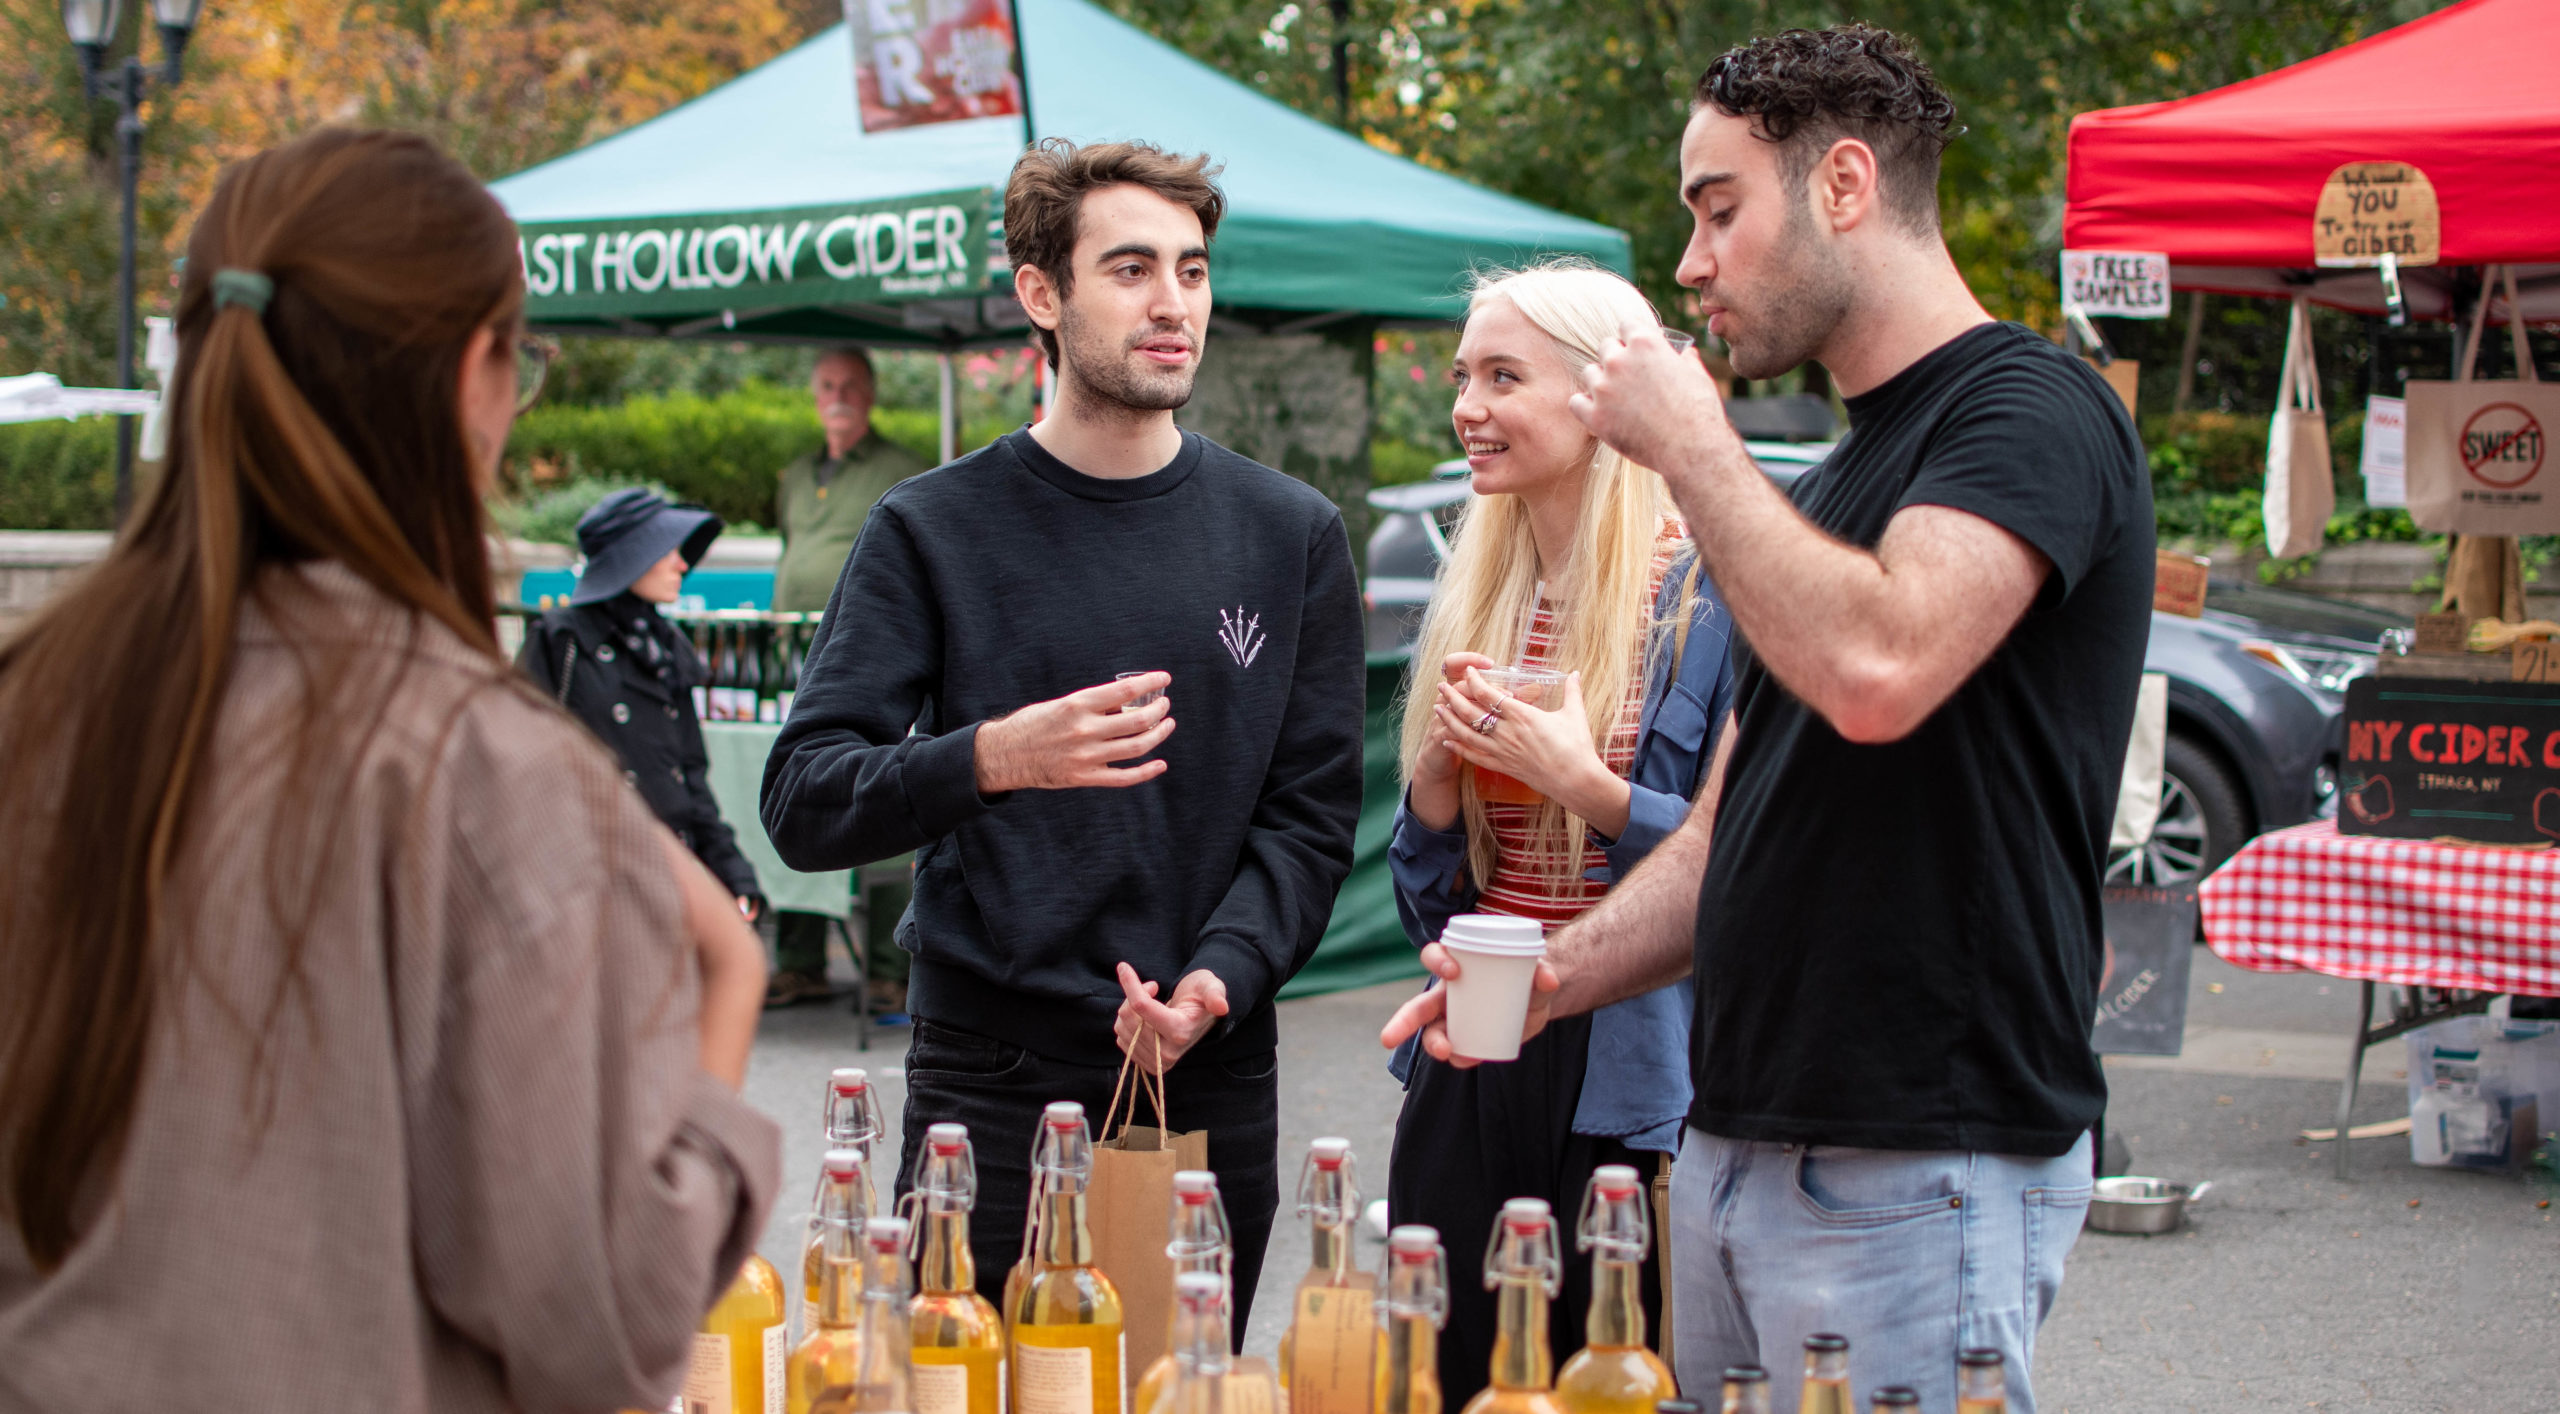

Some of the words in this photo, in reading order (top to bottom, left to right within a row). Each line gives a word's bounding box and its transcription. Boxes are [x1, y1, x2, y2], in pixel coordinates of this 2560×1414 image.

[2348, 189, 2398, 214] YOU
[591, 221, 810, 293] HOLLOW
[815, 205, 969, 280] CIDER
[2343, 233, 2417, 256] CIDER
[2094, 256, 2148, 281] FREE
[2074, 280, 2163, 307] SAMPLES
[2465, 431, 2542, 462] SWEET
[2348, 720, 2404, 763] NY
[2408, 723, 2532, 769] CIDER
[2481, 776, 2502, 792] NY
